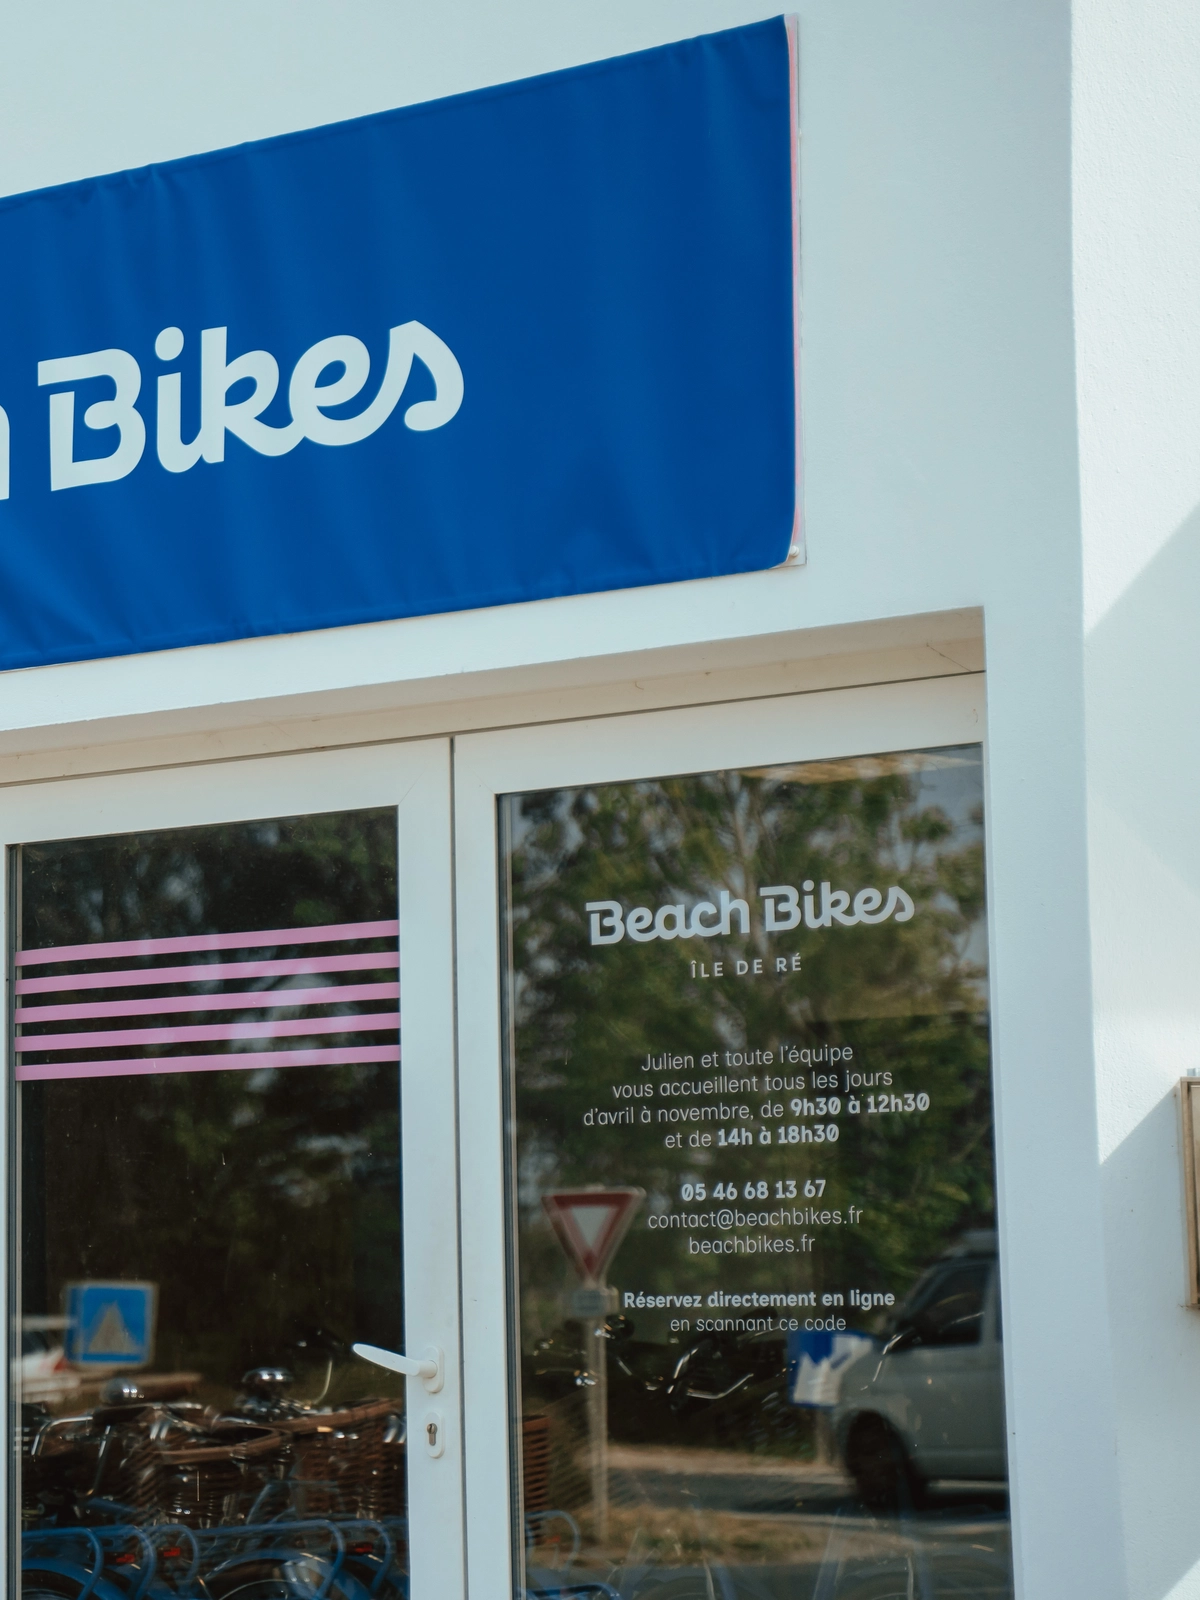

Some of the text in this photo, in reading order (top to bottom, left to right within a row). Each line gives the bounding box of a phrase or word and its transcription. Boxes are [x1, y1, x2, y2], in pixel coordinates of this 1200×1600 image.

[38, 320, 464, 491] Bikes
[585, 879, 915, 946] Beach Bikes
[691, 952, 802, 979] ÎLE DE RÉ
[641, 1044, 853, 1071] Julien et toute l'équipe
[612, 1069, 893, 1099] vous accueillent tous les jours
[583, 1092, 931, 1126] d'avril à novembre, de 9h30 à 12h30
[665, 1123, 840, 1149] et de 14h à 18h30
[681, 1179, 827, 1202] 05 46 68 13 67
[648, 1205, 864, 1230] contact@beachbikes.fr
[689, 1233, 816, 1255] beachbikes.fr
[624, 1289, 895, 1311] Réservez directement en ligne
[670, 1314, 847, 1332] en scannant ce code
